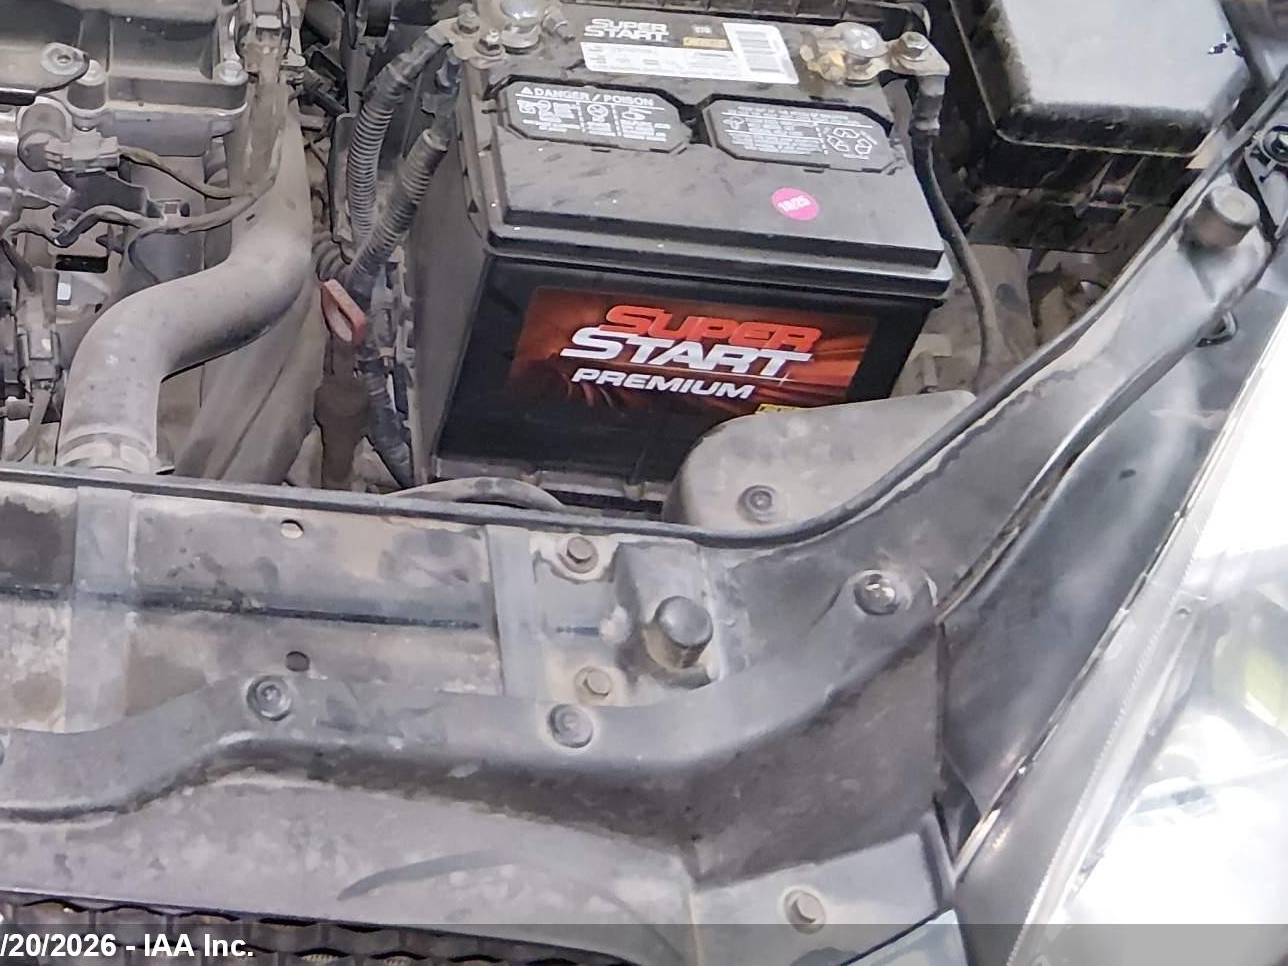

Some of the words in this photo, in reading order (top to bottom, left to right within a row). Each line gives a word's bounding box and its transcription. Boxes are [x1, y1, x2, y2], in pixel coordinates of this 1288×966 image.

[583, 25, 670, 42] START
[591, 18, 668, 33] SUPER
[534, 87, 591, 102] DANGER
[603, 94, 655, 107] POISON
[599, 305, 822, 352] SUPER
[560, 326, 813, 377] START
[571, 367, 756, 400] PREMIUM
